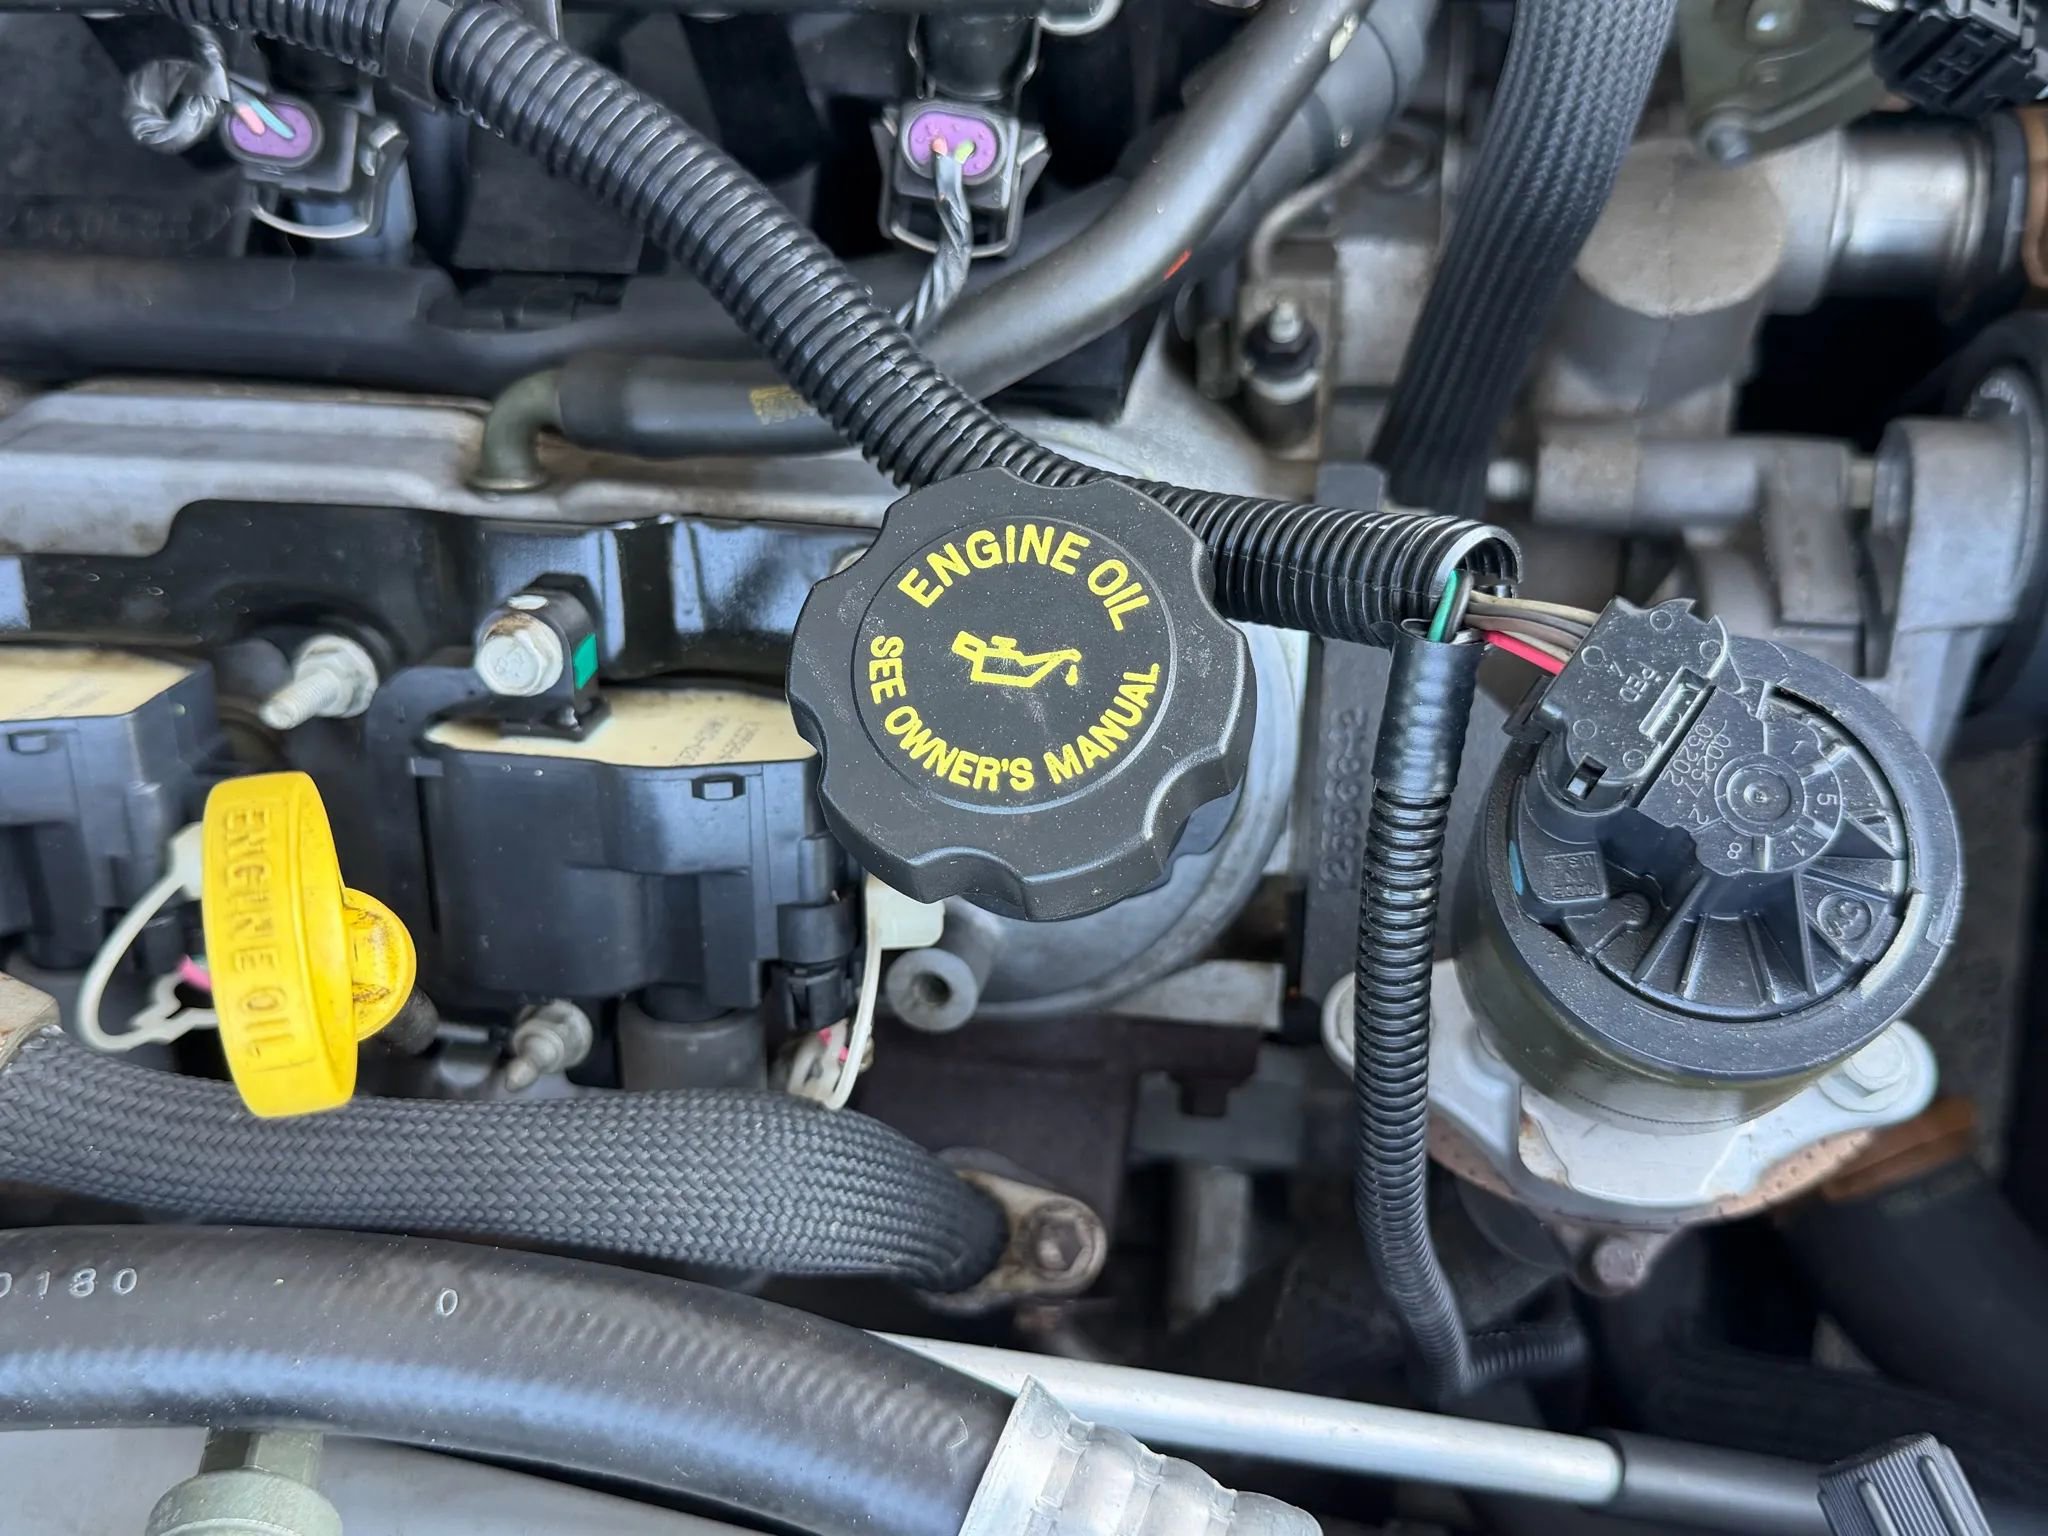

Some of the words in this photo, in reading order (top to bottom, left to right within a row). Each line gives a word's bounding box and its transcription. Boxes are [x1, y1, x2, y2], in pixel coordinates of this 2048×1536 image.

[898, 524, 1090, 608] ENGINE
[1087, 558, 1150, 632] OIL
[869, 634, 906, 704] SEE
[884, 706, 1034, 791] OWNER'S
[1043, 663, 1160, 784] MANUAL
[224, 806, 280, 974] ENGINE
[1726, 842, 1743, 859] 8
[239, 985, 296, 1059] OIL
